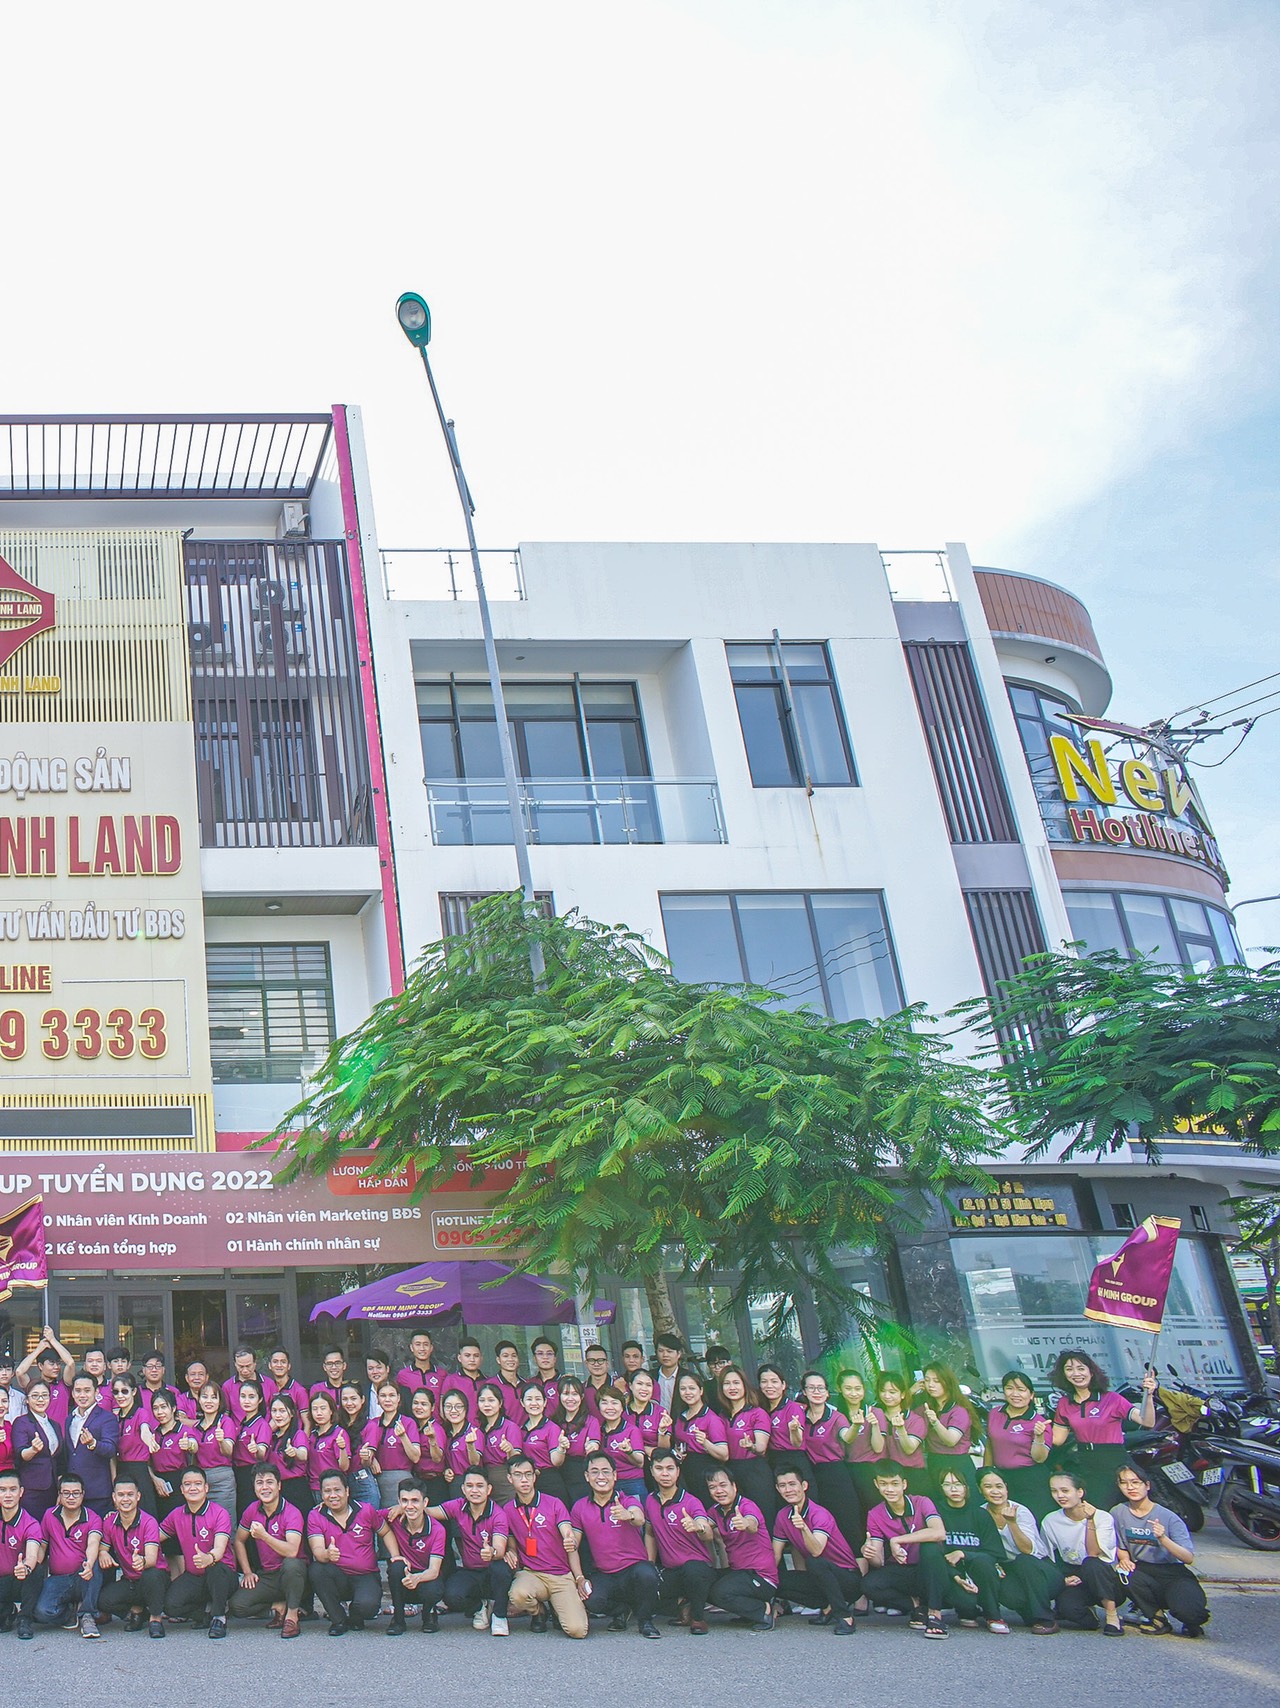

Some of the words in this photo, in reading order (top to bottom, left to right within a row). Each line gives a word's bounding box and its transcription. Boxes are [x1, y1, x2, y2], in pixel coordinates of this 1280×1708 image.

[18, 603, 43, 615] LAND
[25, 675, 61, 693] LAND
[74, 746, 131, 792] SẢN
[68, 814, 184, 876] LAND
[26, 901, 66, 941] VẤN
[70, 901, 110, 941] ĐẦU
[114, 907, 141, 941] TƯ
[144, 909, 185, 941] BĐS
[41, 1007, 169, 1060] 3333
[38, 1163, 124, 1193] TUYỂN
[131, 1171, 205, 1196] DỤNG
[211, 1170, 274, 1191] 2022
[56, 1215, 92, 1227] Nhân
[95, 1213, 125, 1227] viên
[128, 1213, 160, 1226] Kinh
[163, 1212, 207, 1225] Doanh
[225, 1212, 244, 1224] 02
[247, 1210, 284, 1224] Nhân
[286, 1209, 316, 1223] viên
[319, 1208, 389, 1225] Marketing
[392, 1207, 421, 1220] BĐS
[56, 1240, 76, 1254] Kế
[78, 1240, 110, 1254] toán
[112, 1238, 146, 1257] tổng
[148, 1240, 177, 1257] hợp
[227, 1240, 243, 1252] 01
[246, 1237, 282, 1251] Hành
[285, 1236, 324, 1250] chính
[326, 1236, 361, 1250] nhân
[363, 1236, 381, 1251] sự
[1121, 1292, 1158, 1308] GROUP
[1043, 1336, 1056, 1345] TY
